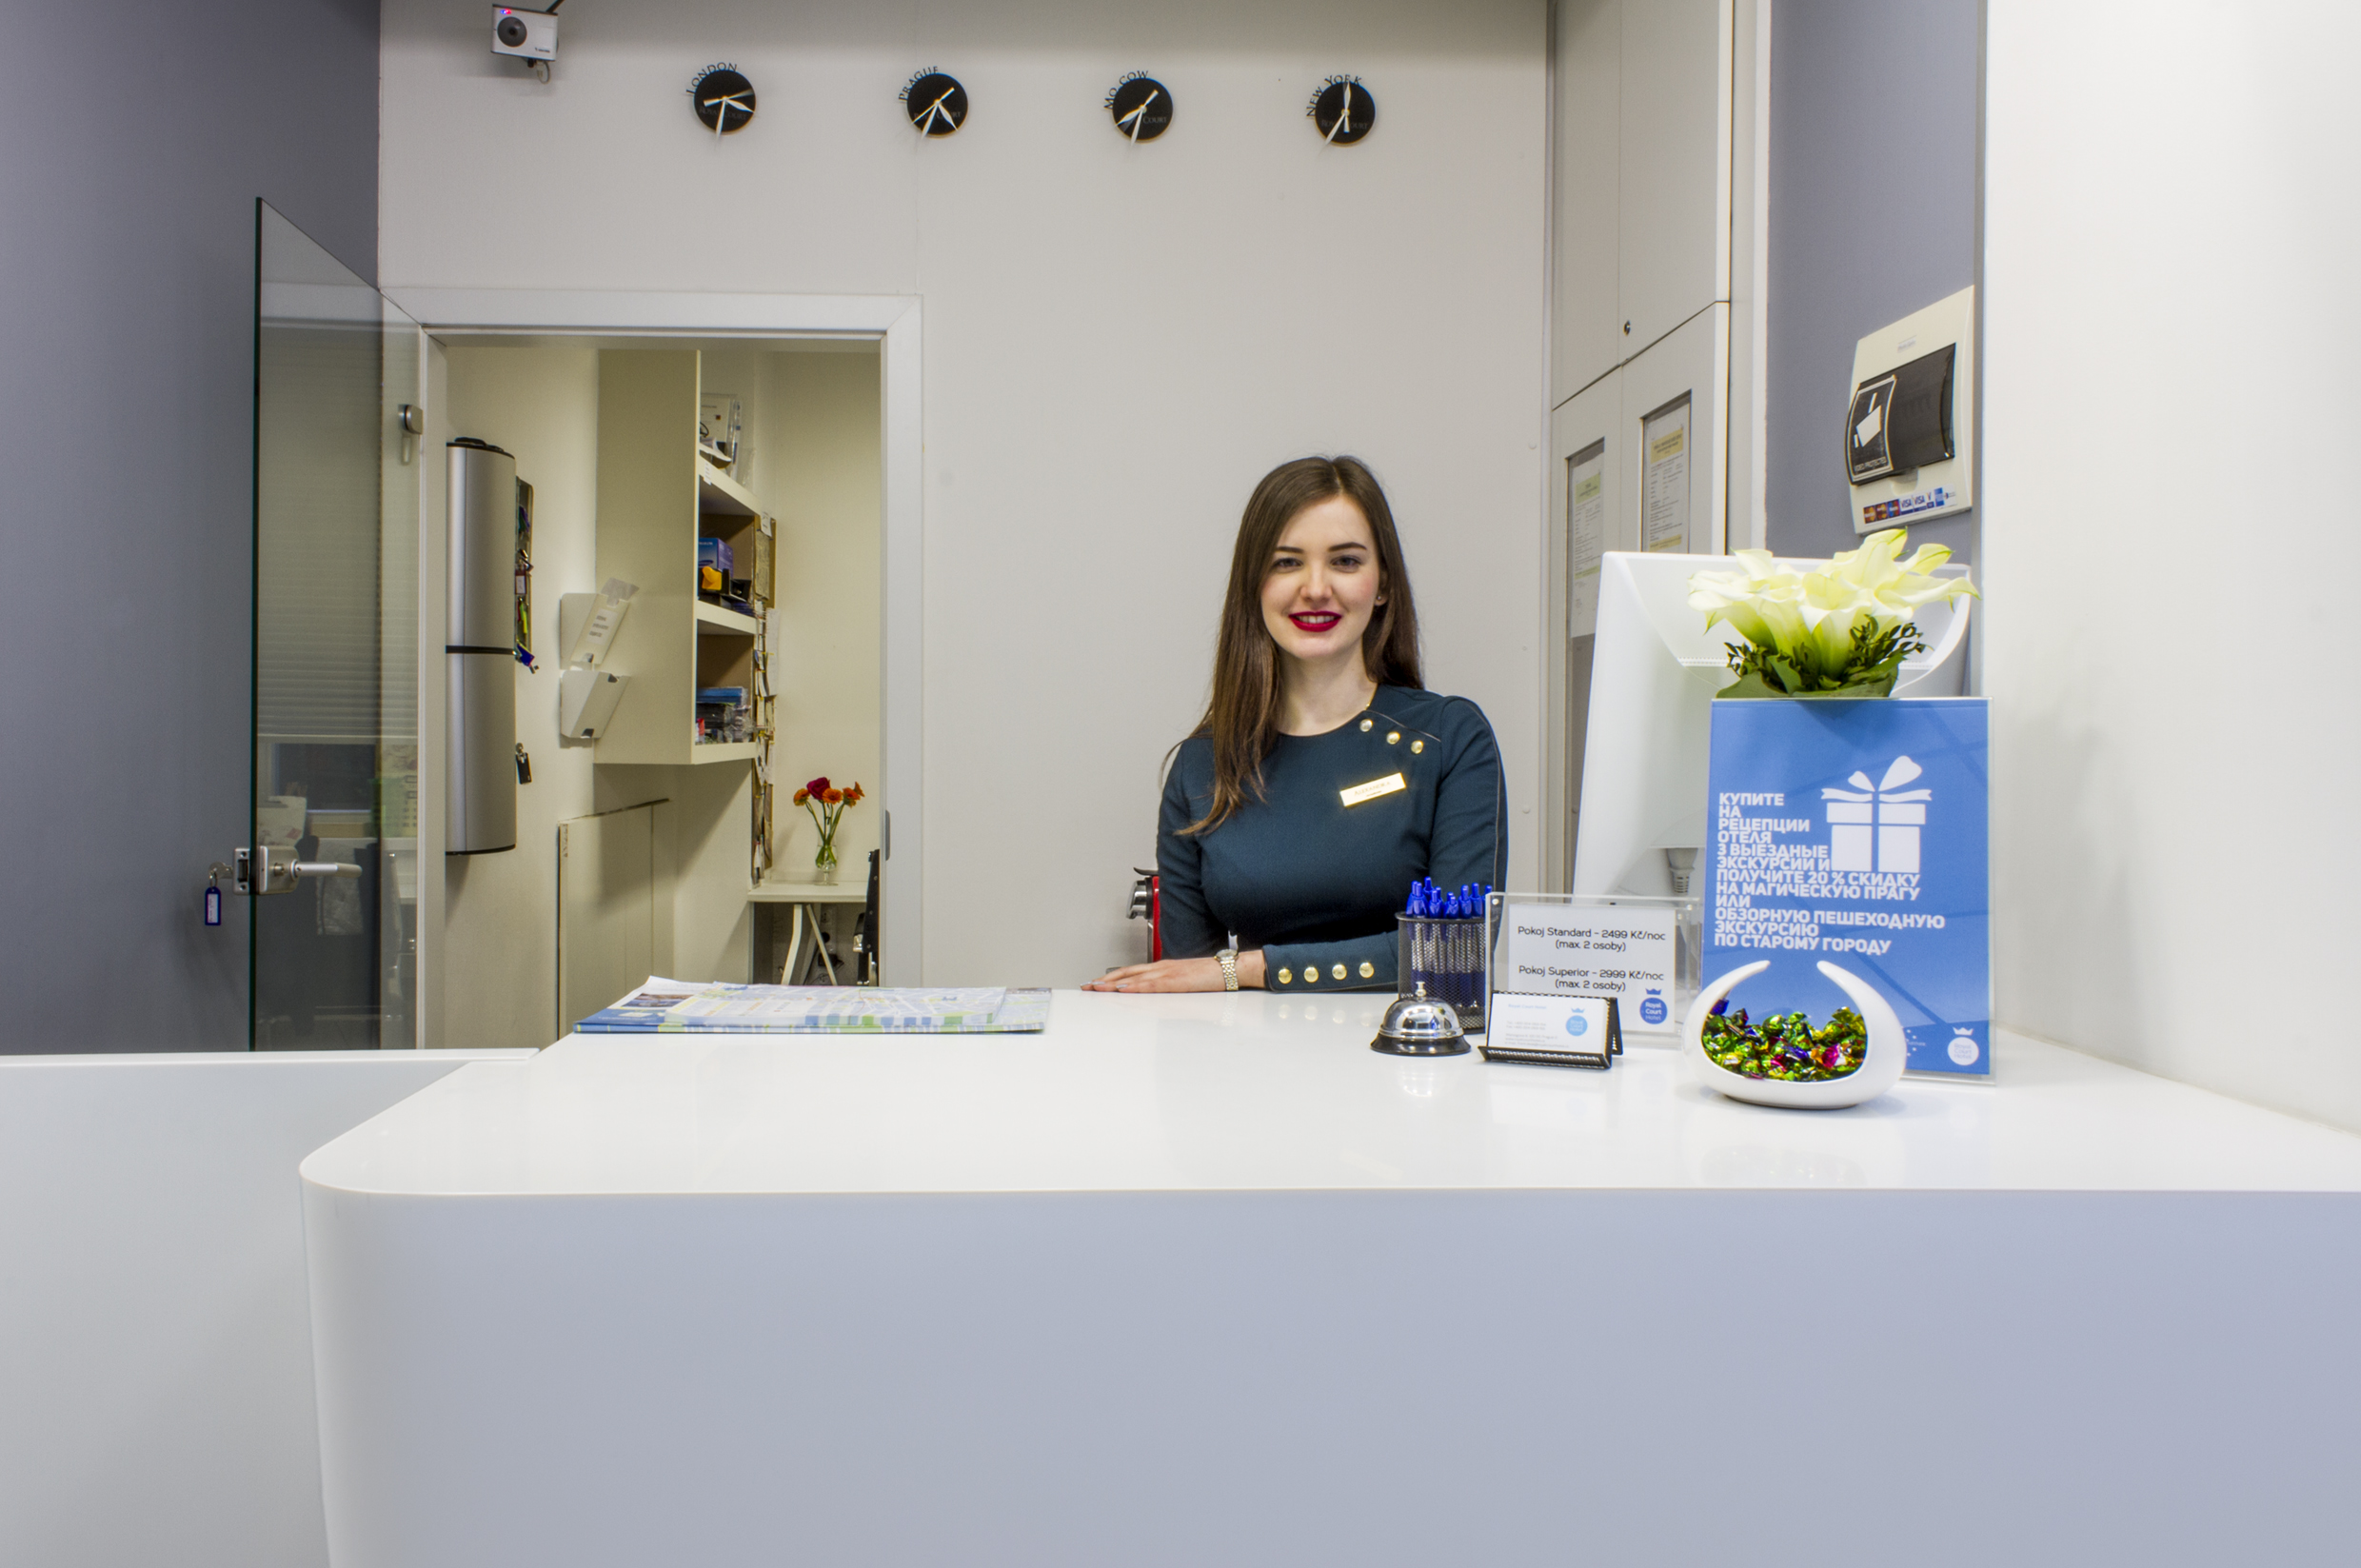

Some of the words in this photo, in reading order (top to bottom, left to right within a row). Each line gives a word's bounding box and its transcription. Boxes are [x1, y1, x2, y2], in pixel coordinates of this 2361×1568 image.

[685, 61, 738, 94] LONDON
[898, 66, 939, 102] PRAGUE
[1305, 86, 1324, 118] NEW
[1719, 792, 1785, 806] КУПИТЕ
[1718, 805, 1742, 818] НА
[1718, 818, 1811, 834] РЕЦЕПЦИИ
[1717, 830, 1773, 844] ОТЕЛЯ
[1730, 844, 1829, 860] ВЫЕЗДНЫЕ
[1716, 856, 1815, 871] ЭКСКУРСИИ
[1817, 858, 1831, 871] И
[1716, 868, 1805, 884] ПОЛУЧИТЕ
[1807, 871, 1828, 884] 20
[1832, 872, 1845, 885] %
[1848, 873, 1920, 888] СКИДКУ
[1716, 882, 1739, 895] НА
[1742, 882, 1861, 899] МАГИЧЕСКУЮ
[1864, 886, 1920, 901] ПРАГУ
[1716, 894, 1751, 908] ИЛИ
[1715, 907, 1811, 923] ОБЗОРНУЮ
[1814, 910, 1946, 929] ПЕШЕХОДНУЮ
[1518, 926, 1545, 938] Pokoj
[1547, 927, 1592, 938] Standard
[1601, 929, 1628, 939] 2499
[1631, 930, 1666, 941] Kč/noc
[1715, 921, 1819, 938] ЭКСКУРСИЮ
[1583, 941, 1590, 949] 2
[1593, 942, 1626, 952] osoby)
[1714, 933, 1737, 947] ПО
[1740, 935, 1820, 951] СТАРОМУ
[1822, 938, 1892, 956] ГОРОДУ
[1518, 965, 1545, 977] Pokoj
[1548, 966, 1589, 978] Superior
[1599, 969, 1626, 979] 2999
[1629, 970, 1664, 981] Kč/noc
[1583, 981, 1590, 989] 2
[1592, 982, 1626, 992] osoby)
